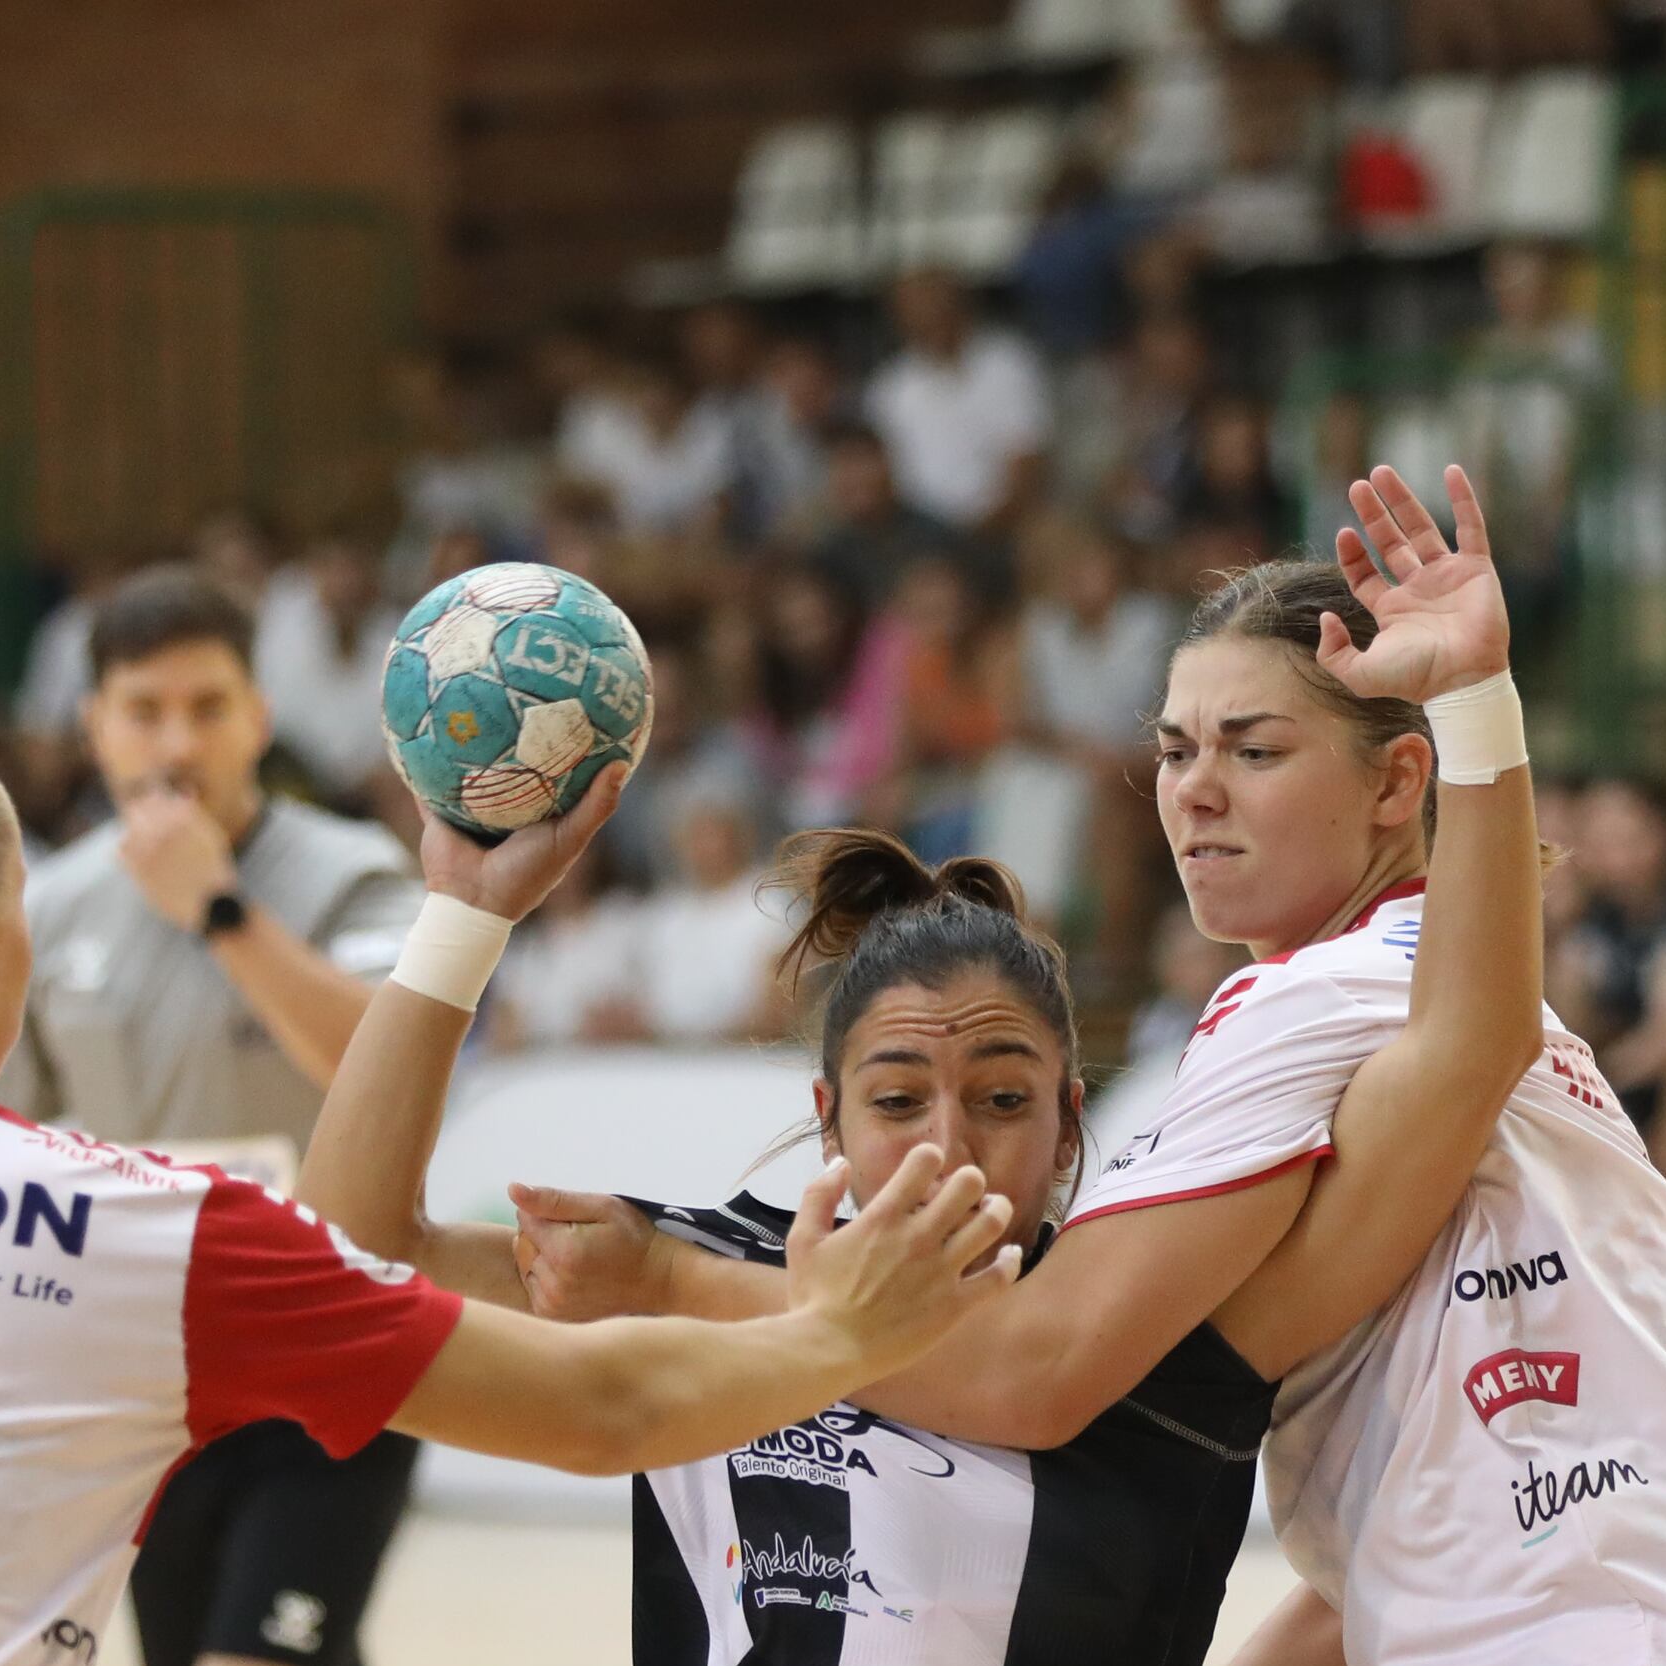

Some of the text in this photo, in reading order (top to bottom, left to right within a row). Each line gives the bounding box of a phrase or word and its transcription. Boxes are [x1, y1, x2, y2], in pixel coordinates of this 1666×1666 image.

[13, 1273, 75, 1307] Life
[734, 1457, 847, 1488] Talento Original
[741, 1531, 884, 1599] Andalucía
